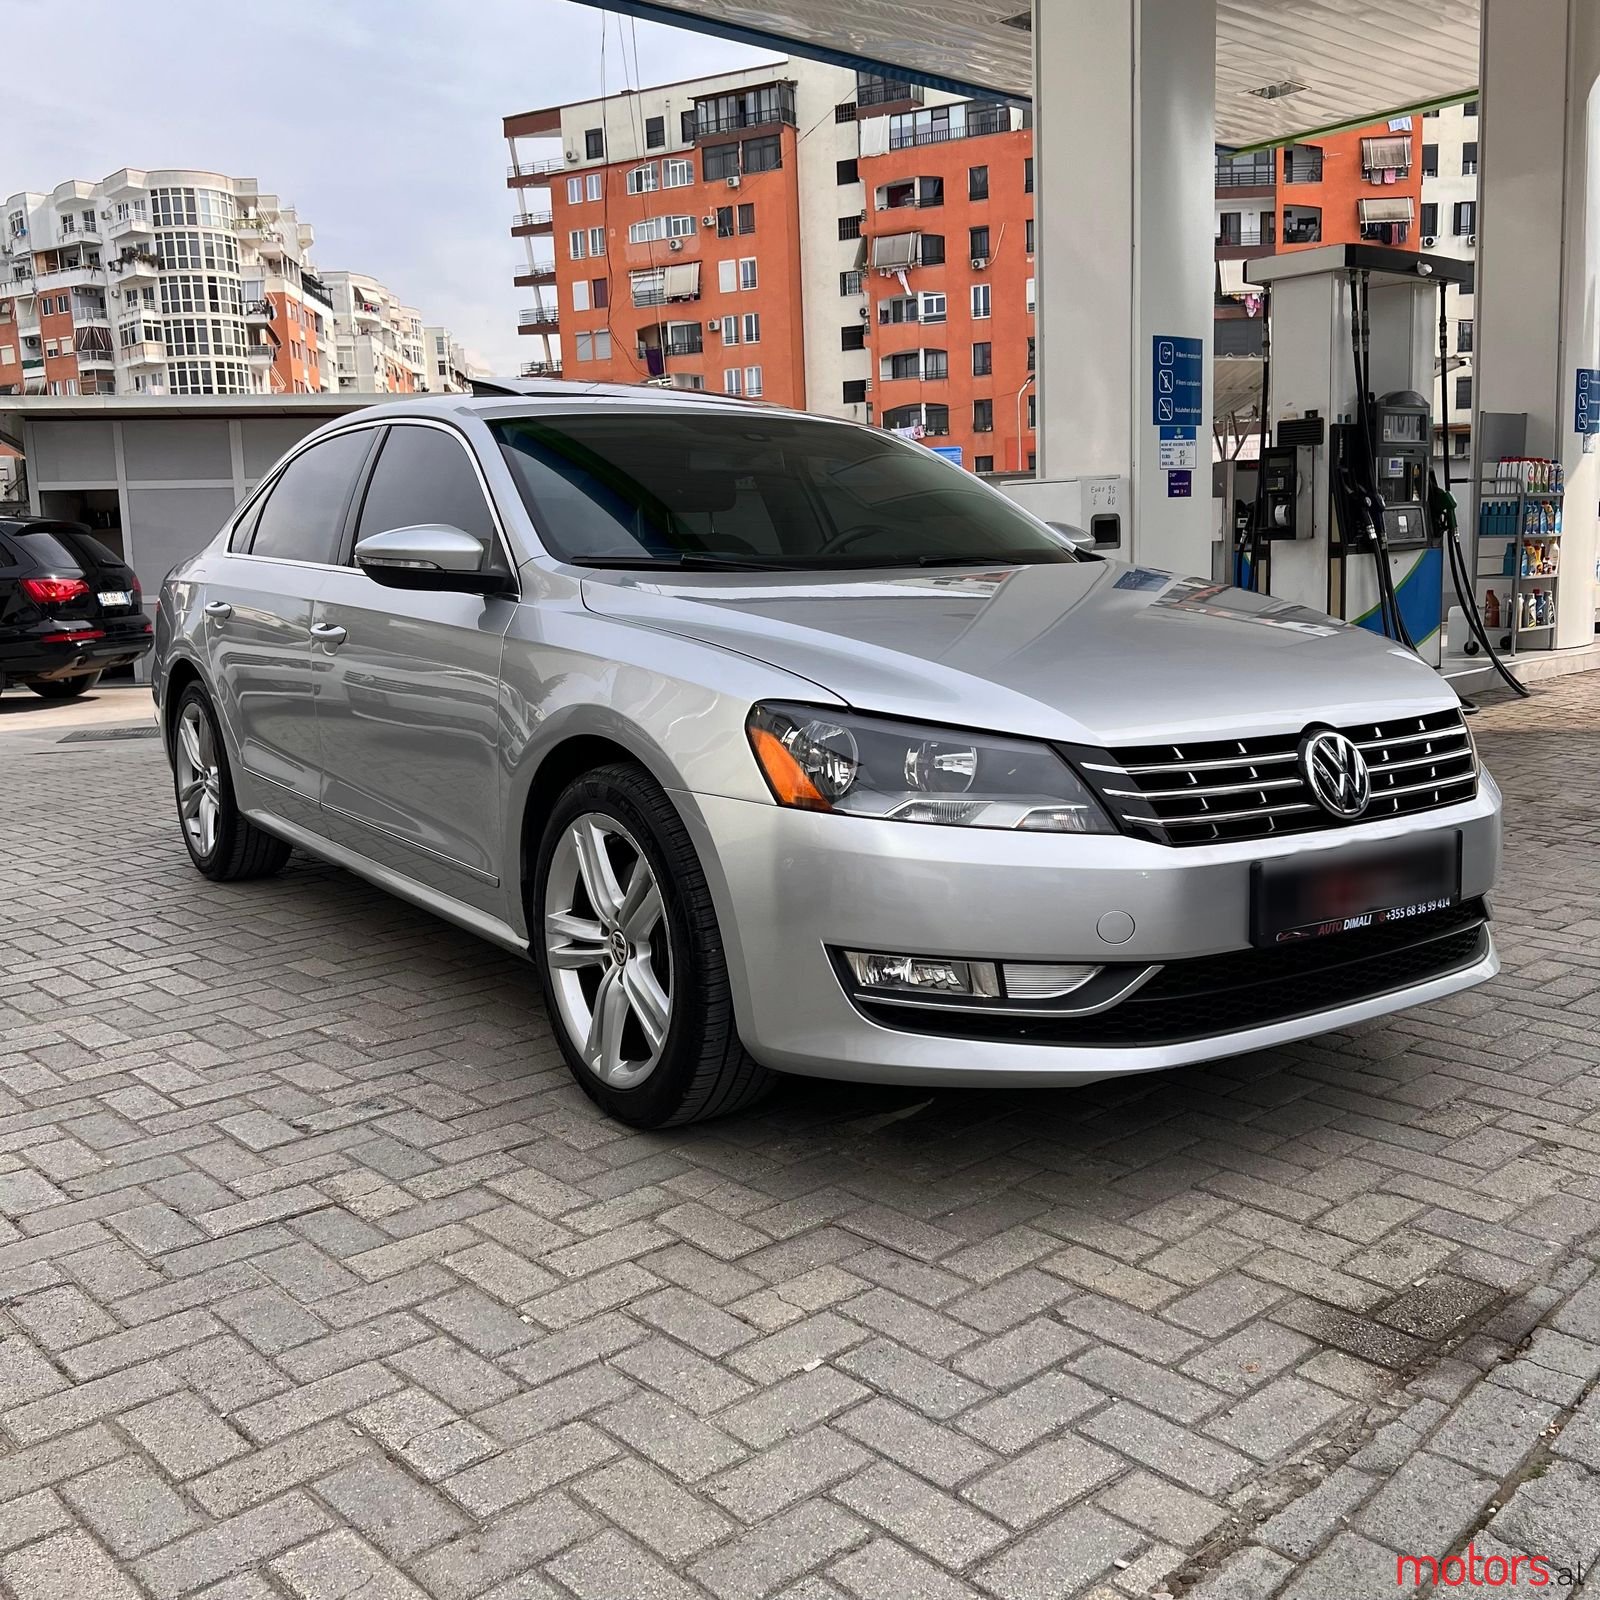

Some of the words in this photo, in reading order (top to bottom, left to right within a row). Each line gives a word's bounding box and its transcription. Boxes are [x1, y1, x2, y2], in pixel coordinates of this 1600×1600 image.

[1318, 920, 1343, 936] AUTO
[1343, 914, 1372, 931] DIMALI
[1385, 908, 1405, 921] +355
[1406, 905, 1416, 916] 68
[1417, 902, 1427, 914] 36
[1427, 901, 1437, 911] 99
[1437, 897, 1450, 909] 414
